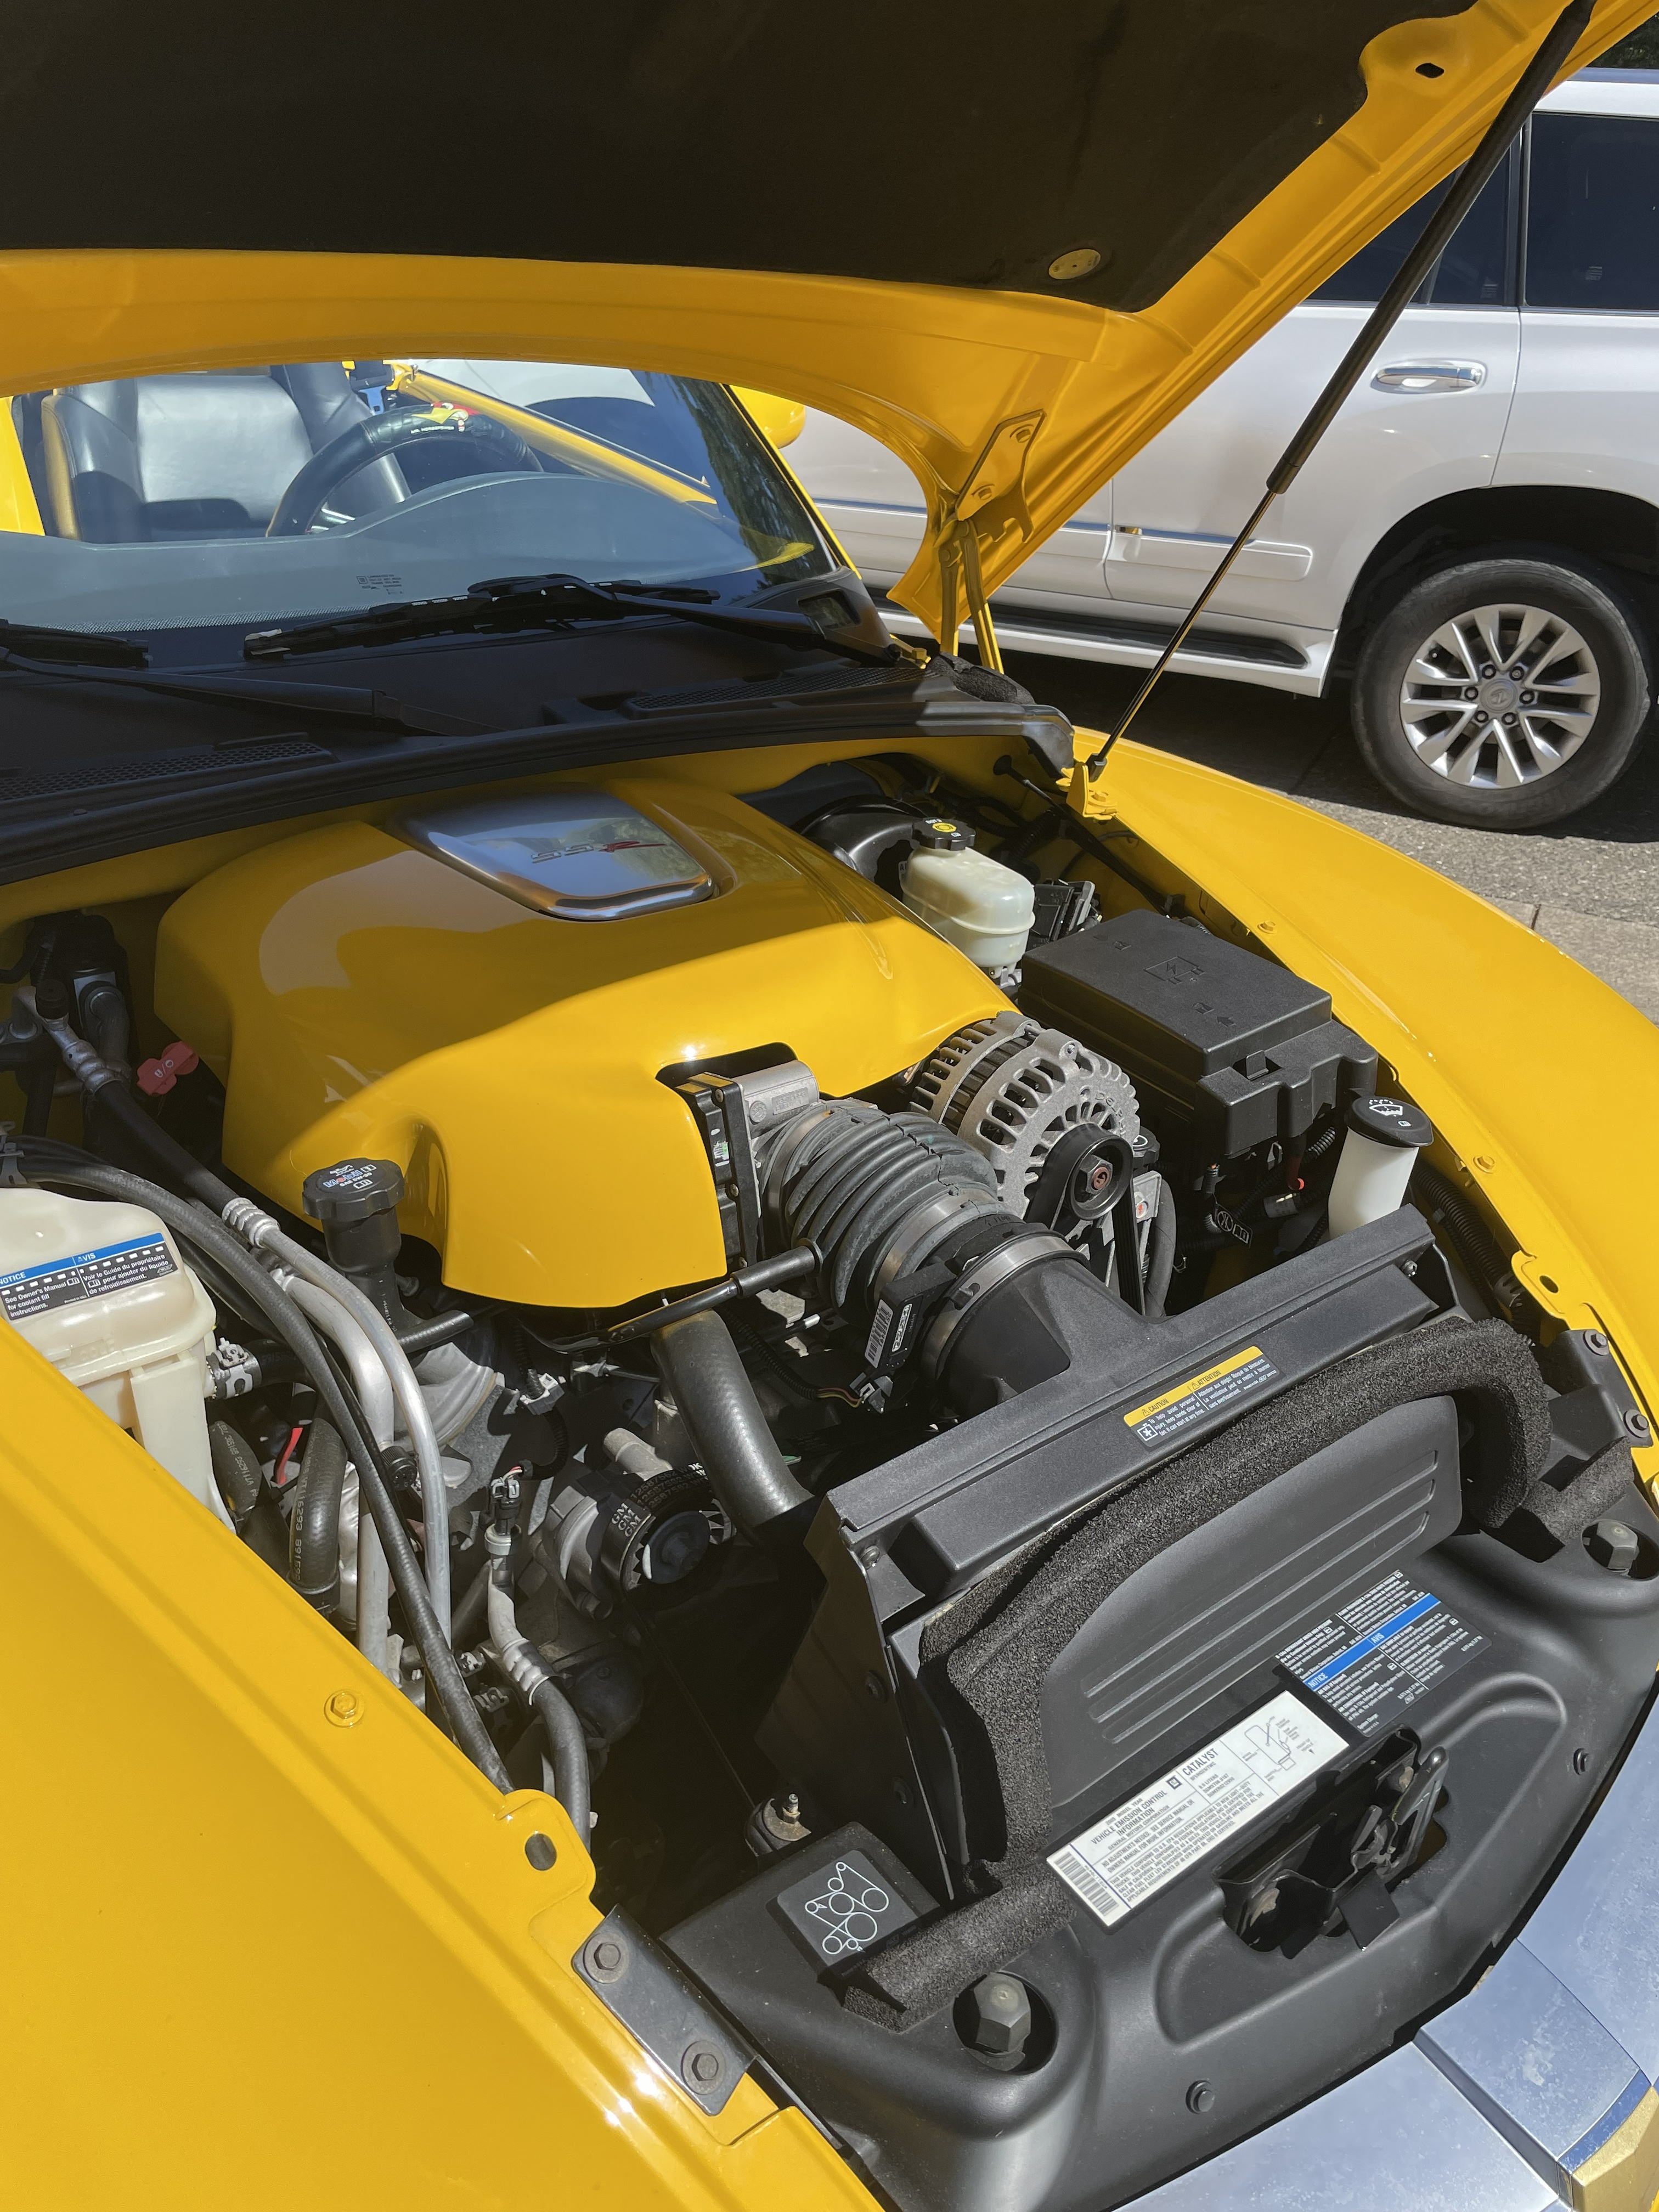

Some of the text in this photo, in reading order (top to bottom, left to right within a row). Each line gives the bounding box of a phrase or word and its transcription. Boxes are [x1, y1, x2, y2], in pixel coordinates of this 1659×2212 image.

[323, 1169, 363, 1188] Mobil
[77, 1253, 95, 1262] AVIS
[103, 1266, 121, 1275] Guide
[131, 1254, 165, 1267] propriétaire
[117, 1268, 138, 1278] ajouter
[148, 1259, 168, 1269] liquide
[98, 1273, 146, 1291] refroidissement.
[5, 1282, 66, 1304] See Owner's Manual
[18, 1296, 40, 1307] coolant
[10, 1302, 48, 1317] instructions.
[1197, 1370, 1221, 1385] ATTENTION
[1148, 1398, 1169, 1412] CAUTION
[1155, 1412, 1166, 1420] help
[1166, 1406, 1178, 1414] avoid
[1178, 1396, 1196, 1408] personal
[611, 1503, 629, 1524] GM
[618, 1509, 635, 1530] GM
[625, 1515, 642, 1537] GM
[1370, 1633, 1384, 1643] AVIS
[1308, 1672, 1328, 1688] NOTICE
[1182, 1748, 1218, 1775] CATALYST
[1091, 1789, 1167, 1844] VEHICLE EMISSION CONTROL
[1116, 1807, 1155, 1836] INFORMATION
[1108, 1805, 1169, 1850] GENERAL MOTORS CORPORATION
[1108, 1842, 1135, 1863] ADJUSTMENTS
[1133, 1830, 1151, 1844] NEEDED.
[1158, 1814, 1173, 1826] SERVICE
[1172, 1803, 1188, 1815] MANUAL
[1108, 1859, 1125, 1872] OWNERS
[1123, 1848, 1139, 1861] MANUAL
[1147, 1835, 1158, 1844] MORE
[1157, 1816, 1183, 1836] INFORMATION.
